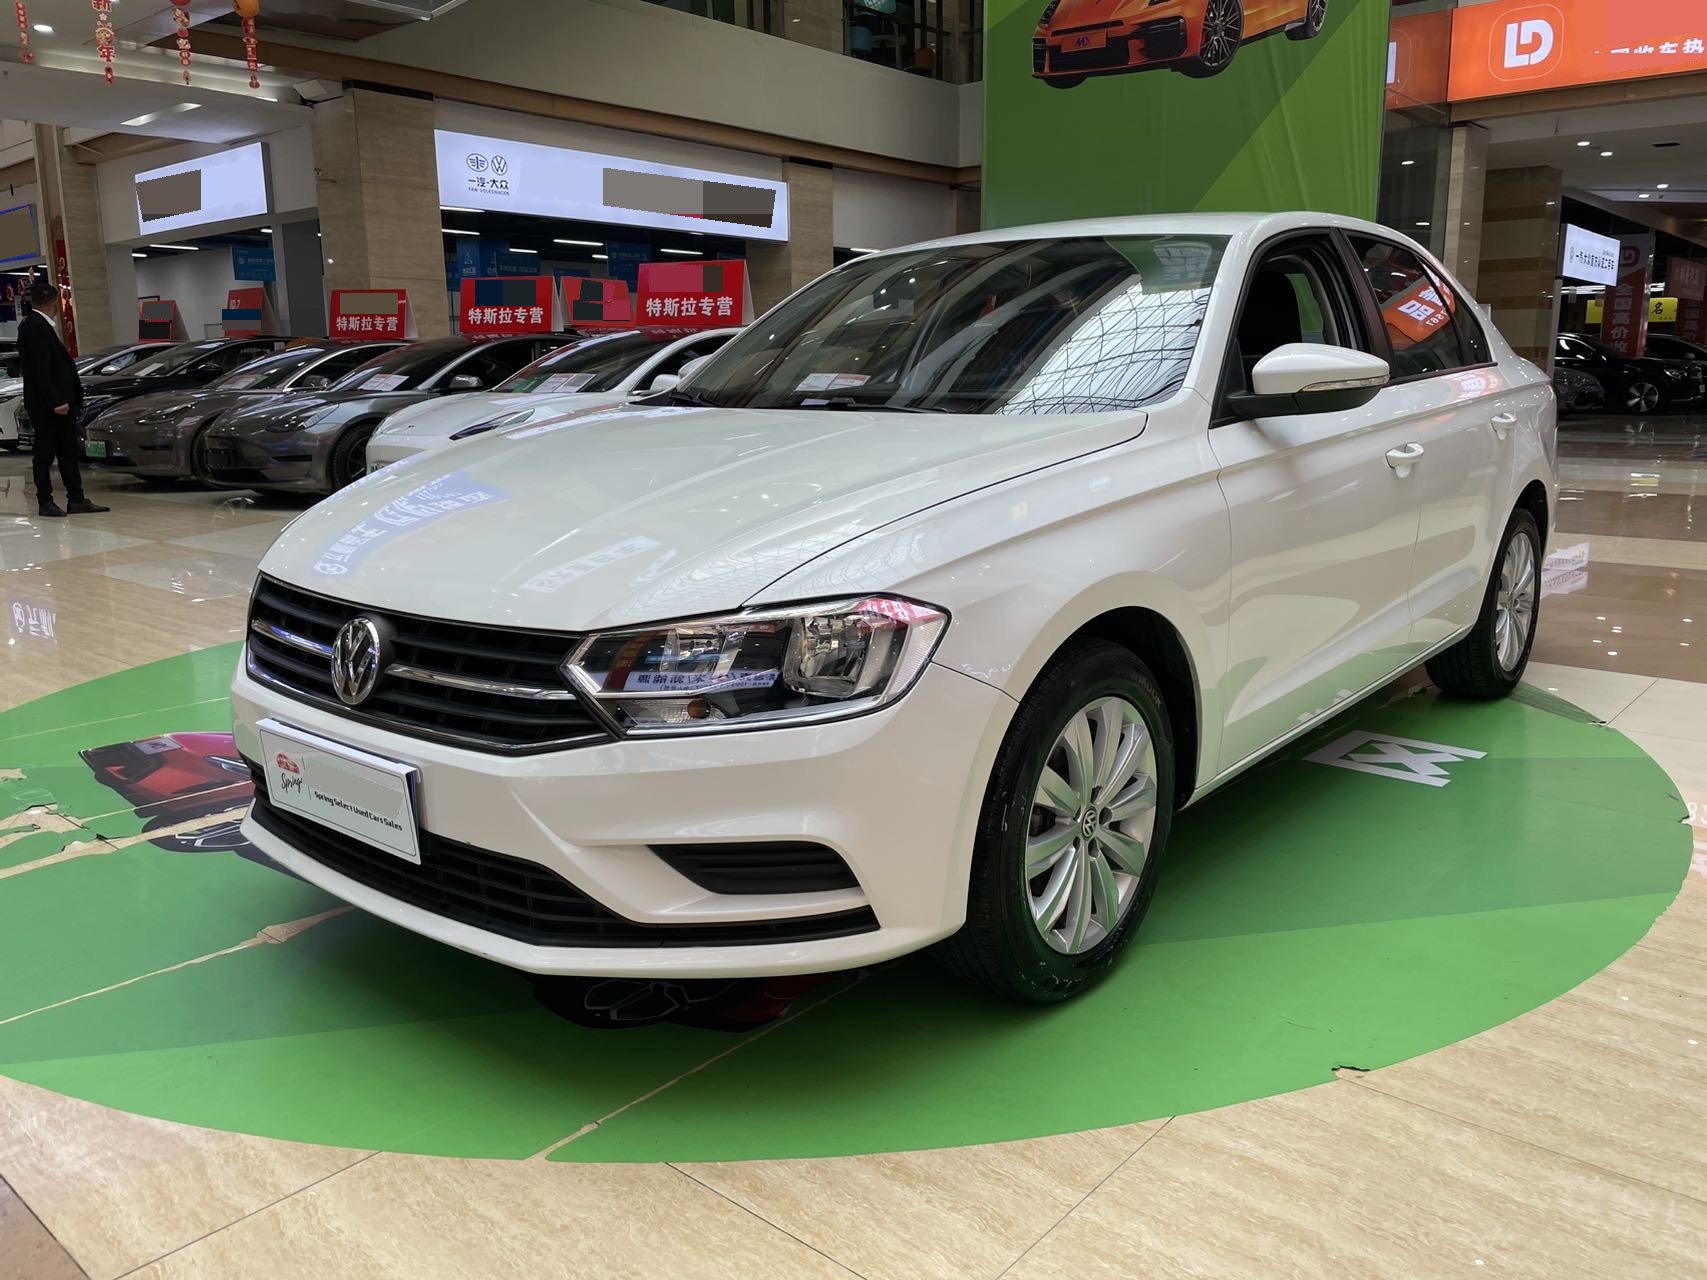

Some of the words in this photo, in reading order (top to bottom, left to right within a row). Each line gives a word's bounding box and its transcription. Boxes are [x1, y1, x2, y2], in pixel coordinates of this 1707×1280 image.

[1503, 19, 1554, 69] LD
[468, 307, 544, 324] 特斯拉专营
[646, 297, 733, 317] 特斯拉专营
[336, 315, 398, 332] 特斯拉专营
[314, 791, 335, 806] Spring
[333, 798, 353, 812] Select
[353, 806, 369, 818] Used
[369, 812, 384, 824] Cars
[383, 818, 403, 831] Sales
